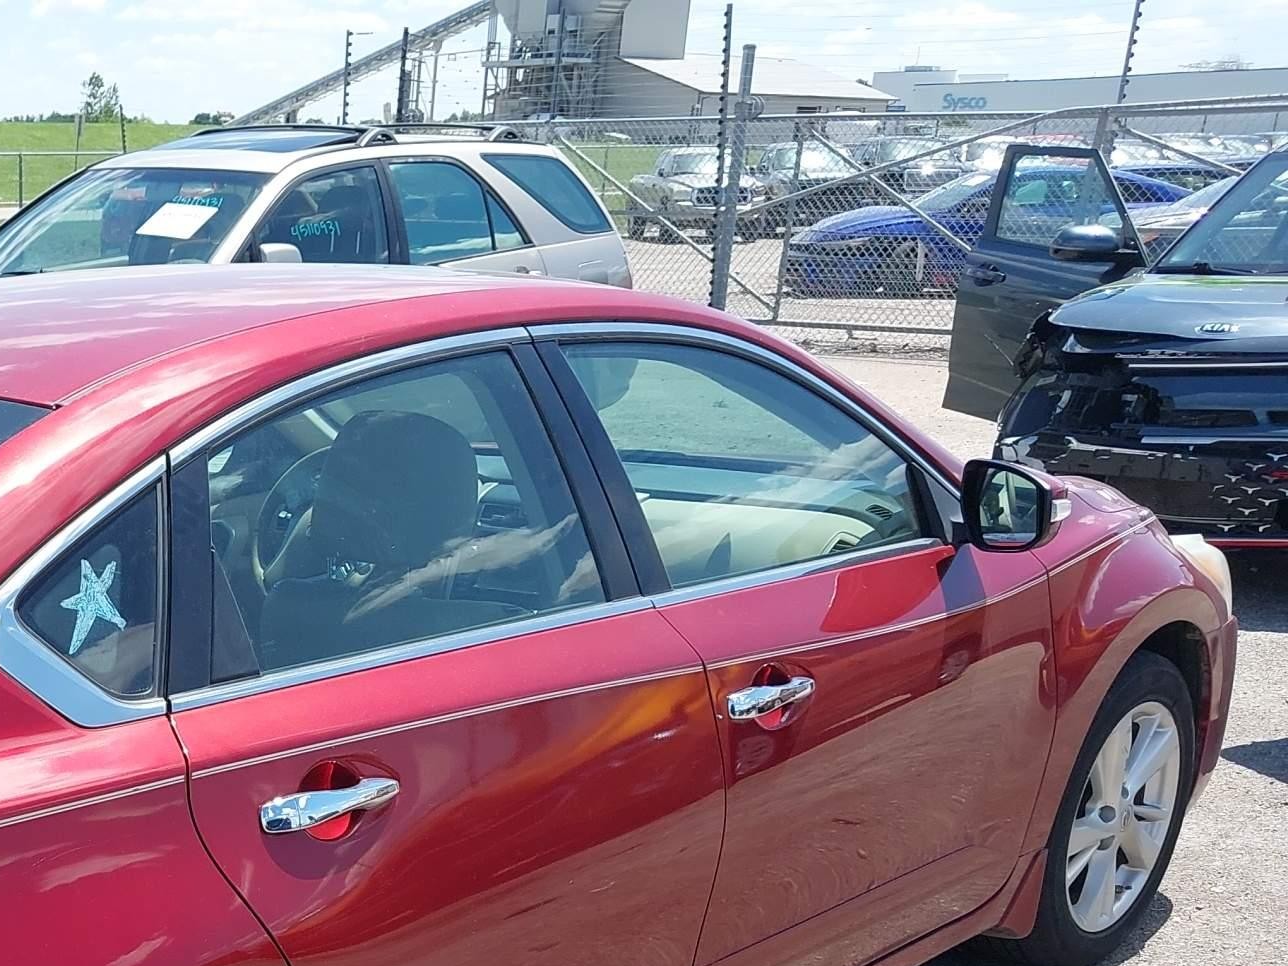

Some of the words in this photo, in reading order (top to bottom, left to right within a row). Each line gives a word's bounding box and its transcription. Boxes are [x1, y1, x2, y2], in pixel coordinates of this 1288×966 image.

[942, 93, 987, 112] Sysco
[290, 220, 341, 241] 45110931
[1202, 322, 1231, 333] KIA
